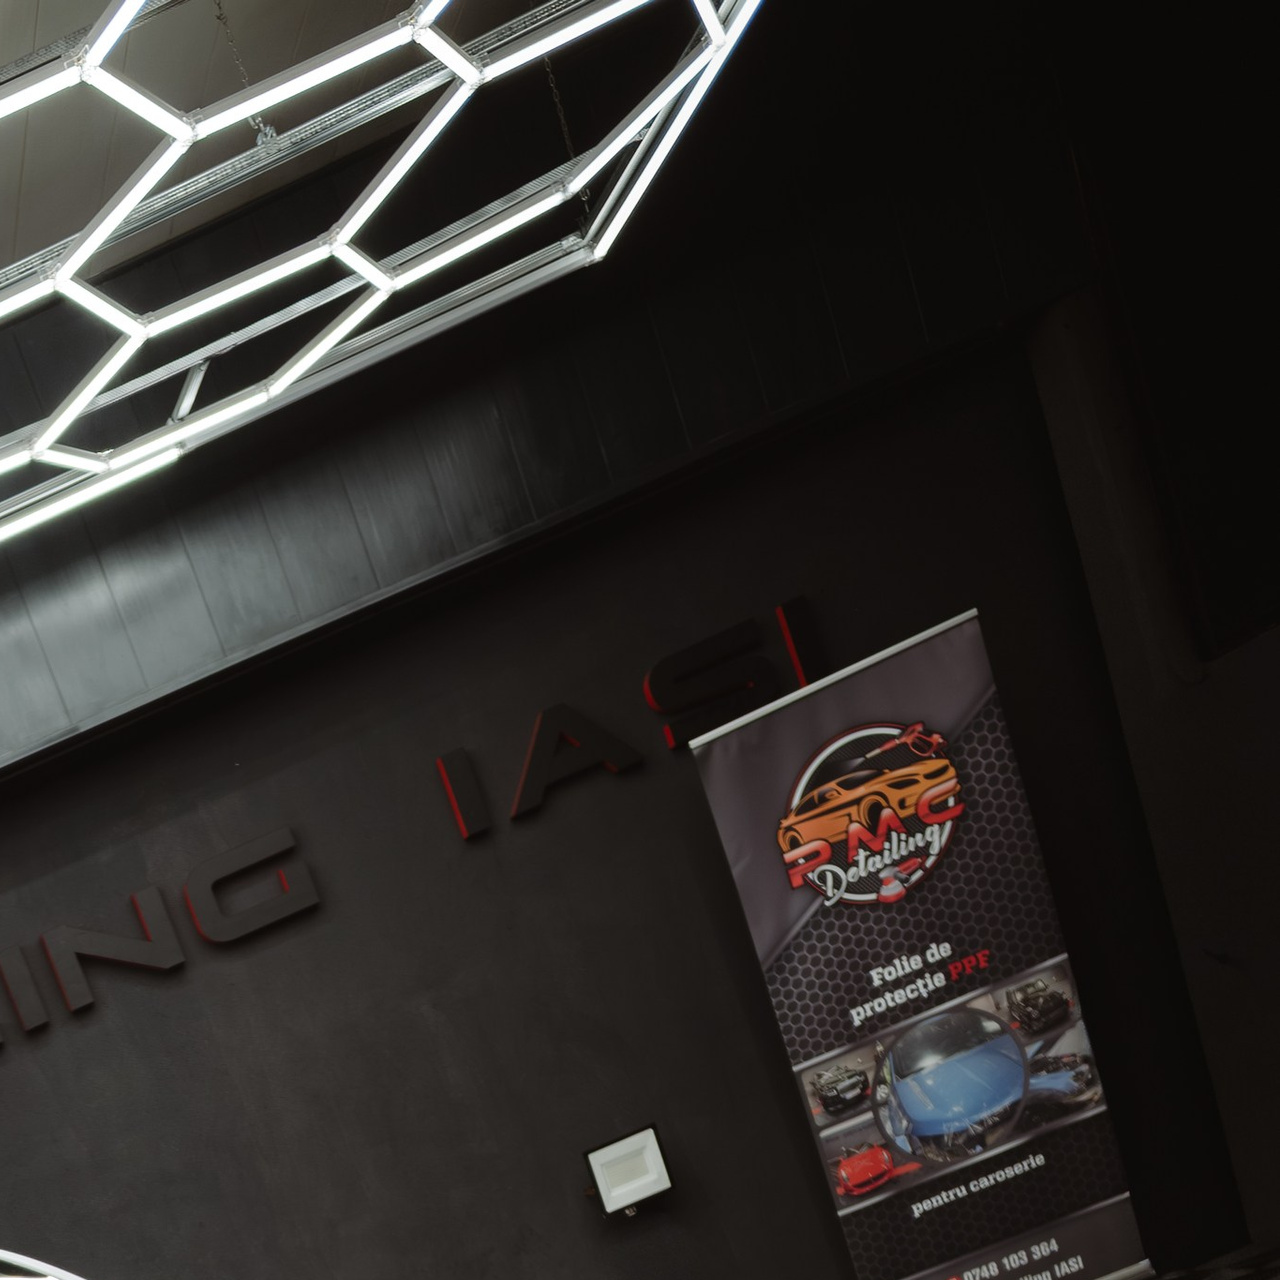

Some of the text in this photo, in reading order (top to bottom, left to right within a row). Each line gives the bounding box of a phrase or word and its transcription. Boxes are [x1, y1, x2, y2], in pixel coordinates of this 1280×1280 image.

[436, 596, 825, 841] IASI
[782, 777, 966, 890] PMC
[813, 824, 941, 907] Detailing
[869, 941, 952, 987] Folie de
[948, 949, 991, 982] PPF
[910, 1153, 1046, 1219] pentru caroserie
[1001, 1249, 1028, 1271] 103
[1053, 1255, 1083, 1279] IASI
